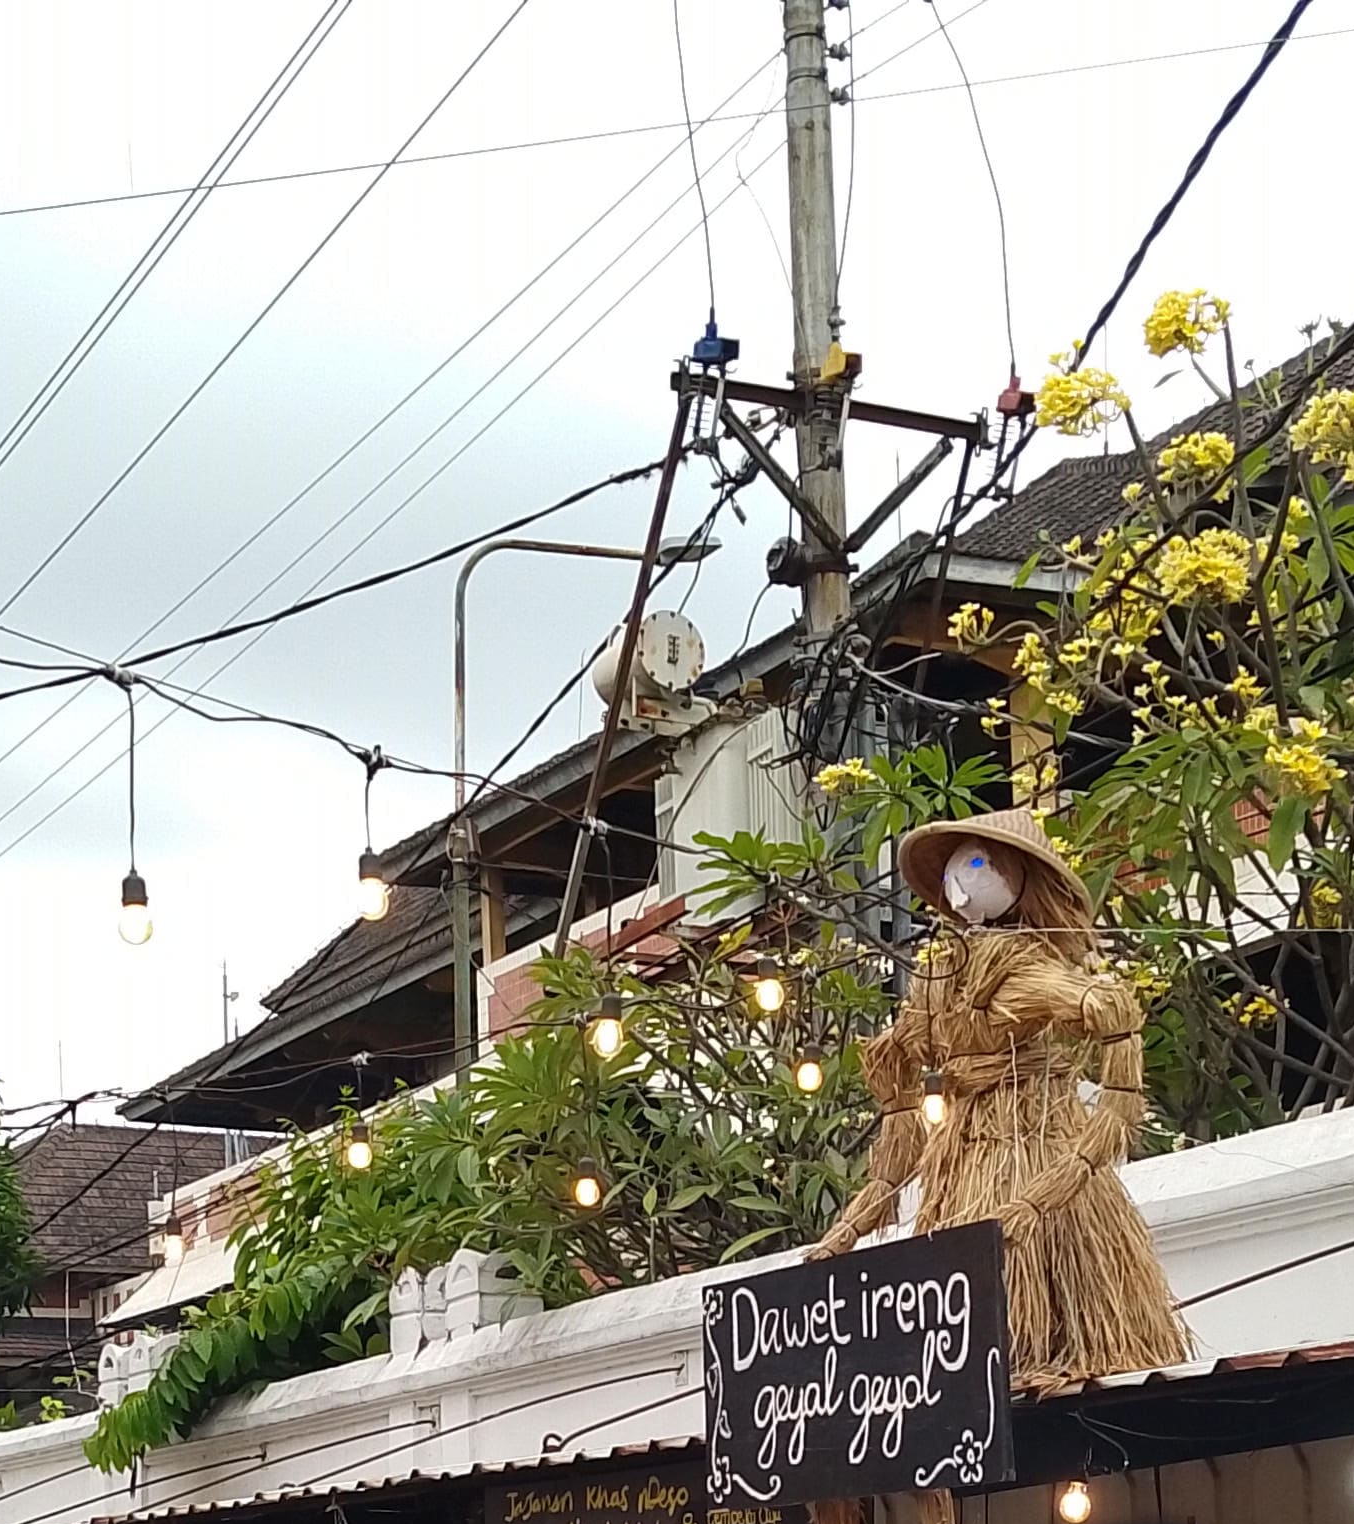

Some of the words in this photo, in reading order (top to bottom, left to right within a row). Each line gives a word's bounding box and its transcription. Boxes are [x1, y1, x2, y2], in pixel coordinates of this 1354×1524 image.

[731, 1275, 851, 1372] Dawet
[859, 1271, 972, 1373] ireng
[753, 1345, 844, 1470] geyal
